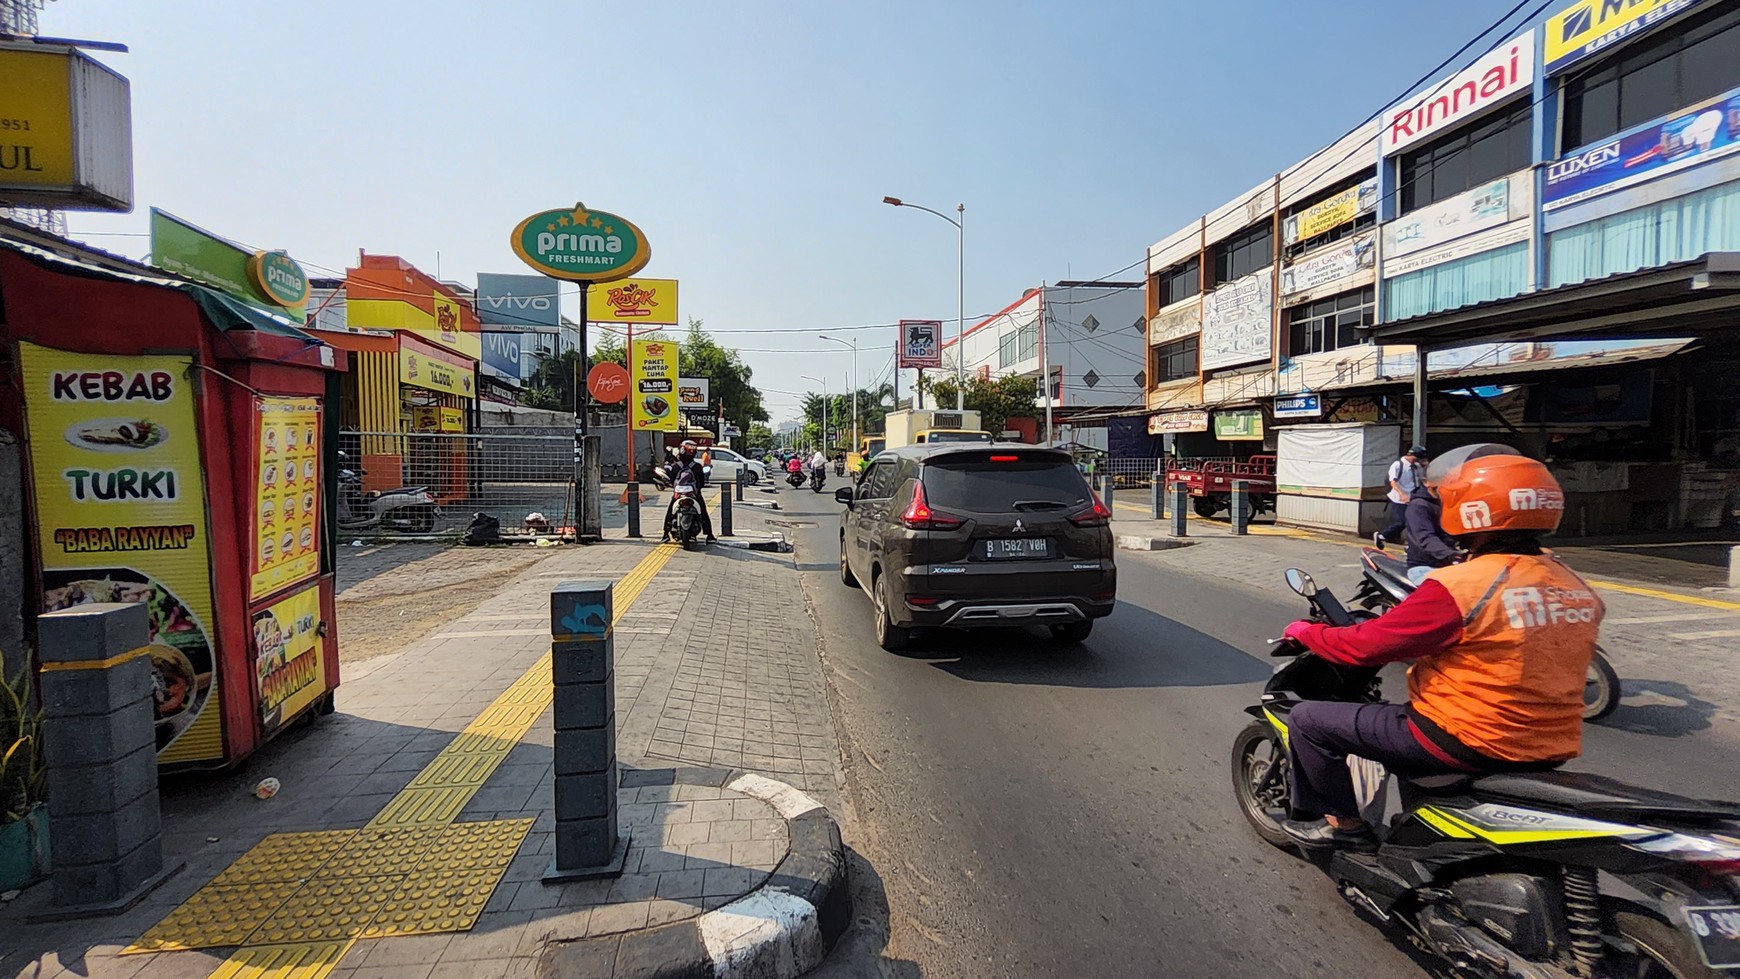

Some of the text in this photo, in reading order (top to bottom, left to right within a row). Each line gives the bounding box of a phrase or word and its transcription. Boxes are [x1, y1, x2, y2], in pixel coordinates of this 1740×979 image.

[1583, 21, 1641, 54] KARYA
[1391, 46, 1519, 145] Rinnai
[1547, 140, 1621, 181] LUXEN
[537, 232, 622, 256] prima
[549, 255, 614, 265] FRESHMART
[267, 265, 302, 291] prima
[487, 291, 551, 310] vivo
[908, 348, 933, 356] INDO
[53, 371, 172, 401] KEBAB
[1277, 400, 1306, 409] PHILIPS
[66, 469, 175, 499] TURKI
[987, 540, 994, 552] B
[1000, 539, 1022, 552] 1582
[1690, 912, 1710, 937] B
